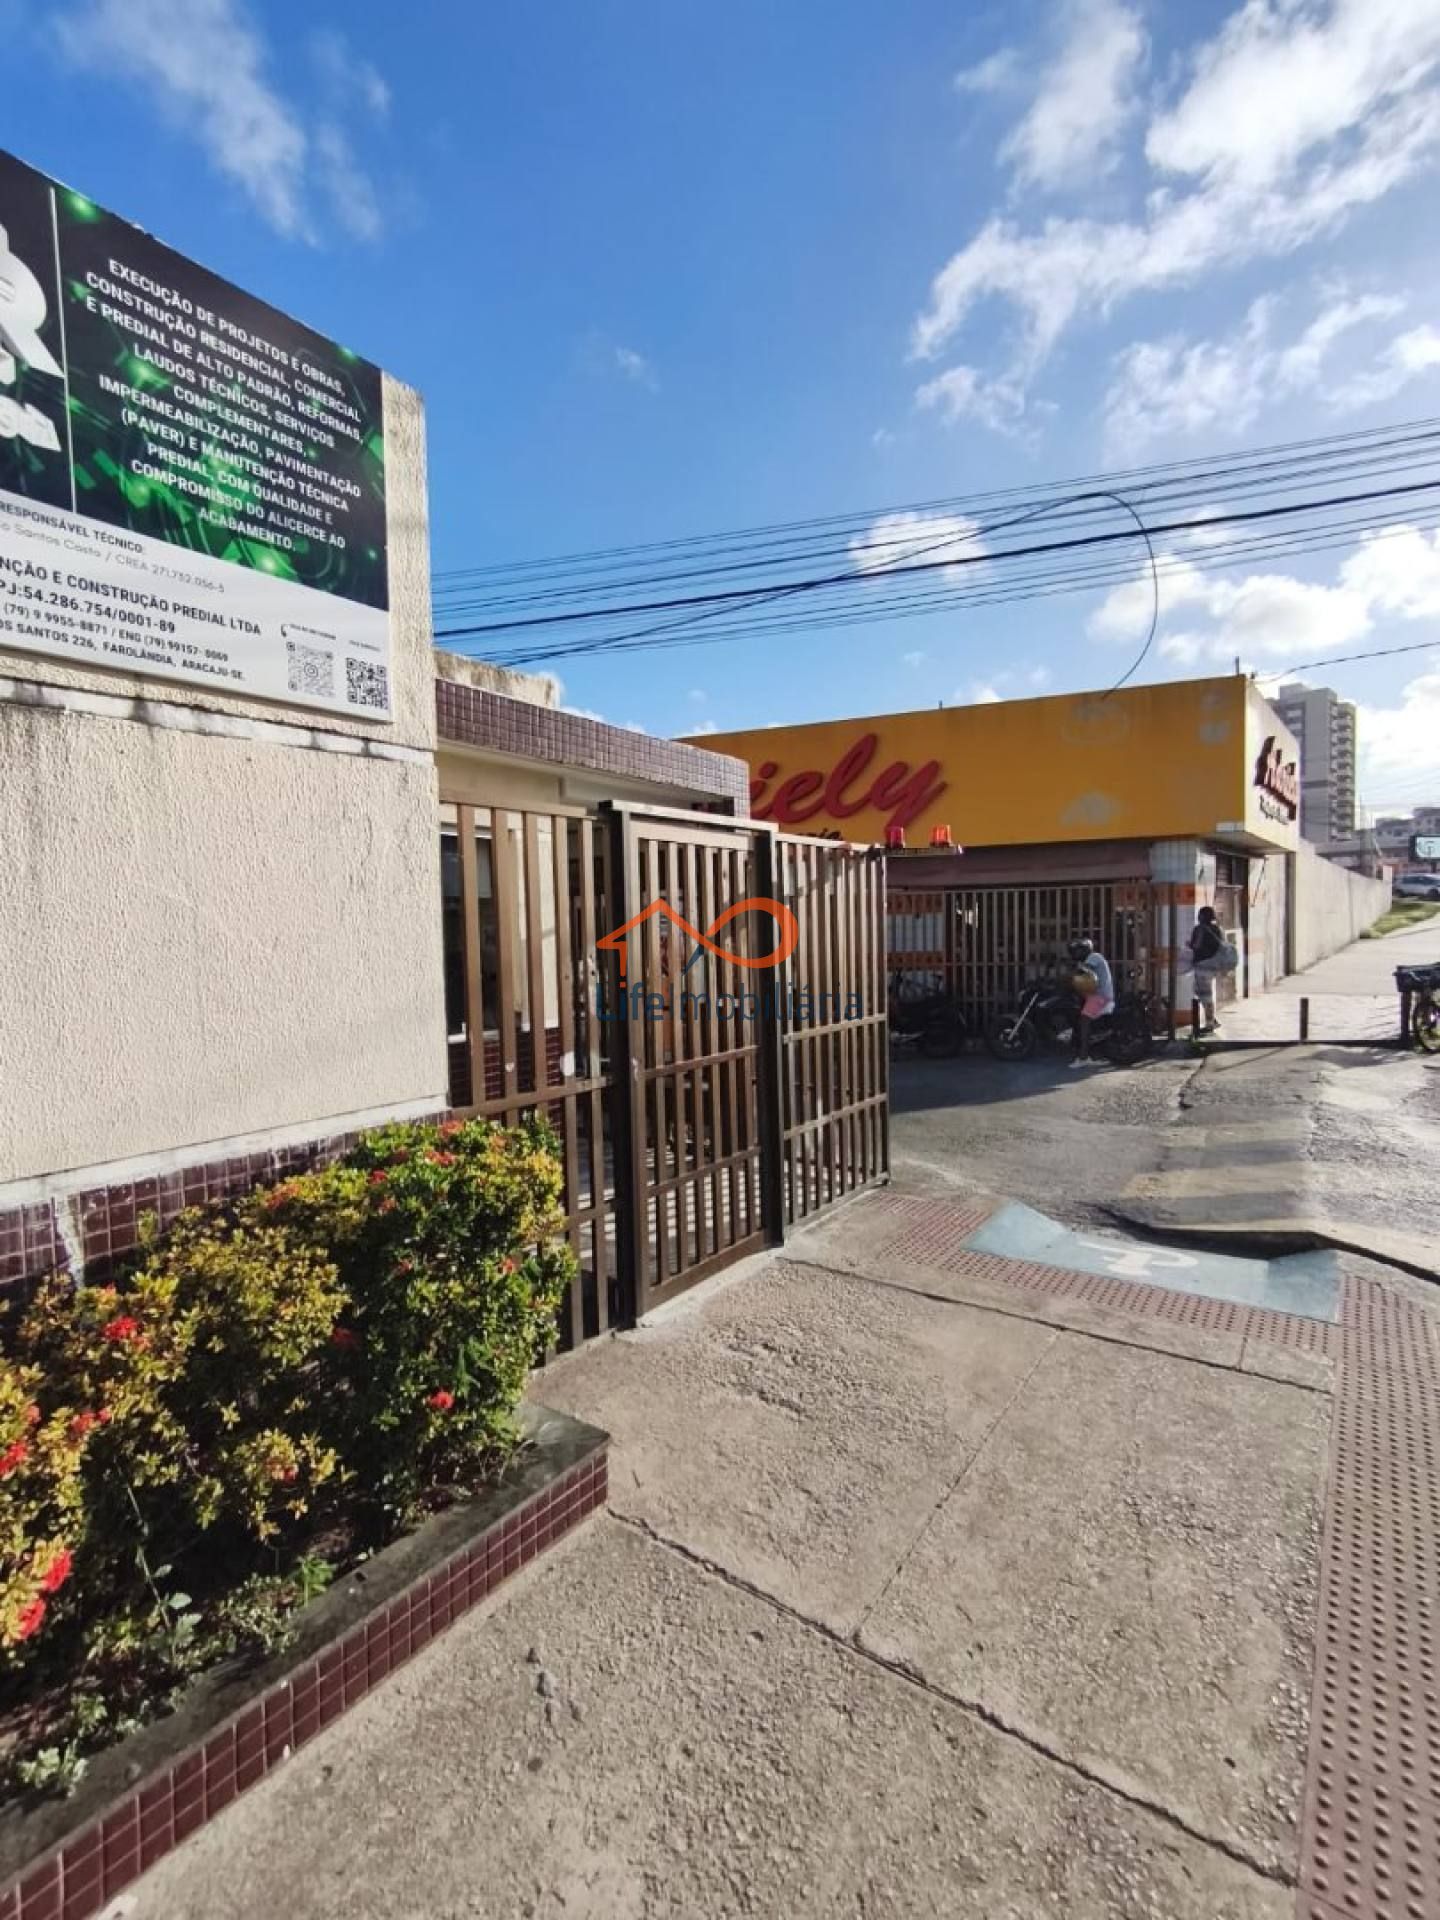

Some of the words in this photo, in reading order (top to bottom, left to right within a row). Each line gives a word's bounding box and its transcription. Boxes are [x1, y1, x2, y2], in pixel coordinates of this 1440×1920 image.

[86, 271, 196, 339] CONSTRUÇÃO
[201, 330, 291, 389] RESIDENCIAL,
[294, 379, 361, 423] COMERCIAL
[108, 258, 192, 314] EXECUÇÃO
[195, 306, 216, 326] DE
[218, 317, 289, 365] PROJETOS
[291, 356, 299, 371] E
[302, 363, 346, 397] OBRAS,
[86, 296, 97, 313] E
[100, 303, 170, 348] PREDIAL
[173, 339, 193, 359] DE
[197, 351, 234, 378] ALTO
[237, 370, 295, 411] PADRÃO,
[298, 401, 364, 445] REFORMAS,
[134, 343, 196, 383] LAUDOS
[275, 410, 335, 448] SERVIÇOS
[122, 408, 185, 448] (PAVER)
[189, 436, 198, 450] E
[201, 441, 295, 490] MANUTENÇÃO
[299, 481, 349, 512] TÉCNICA
[218, 470, 250, 493] COM
[253, 481, 323, 522] QUALIDADE
[324, 512, 333, 525] E
[266, 447, 362, 497] PAVIMENTAÇÃO
[131, 459, 242, 511] COMPROMISSO
[246, 502, 265, 519] DO
[268, 511, 327, 542] ALICERCE
[329, 534, 346, 549] AO
[200, 507, 296, 551] ACABAMENTO.
[3, 602, 29, 619] (79)
[17, 623, 69, 643] SANTOS
[53, 571, 62, 584] E
[67, 575, 169, 612] CONSTRUÇÃO
[172, 602, 227, 626] PREDIAL
[230, 618, 261, 635] LTDA
